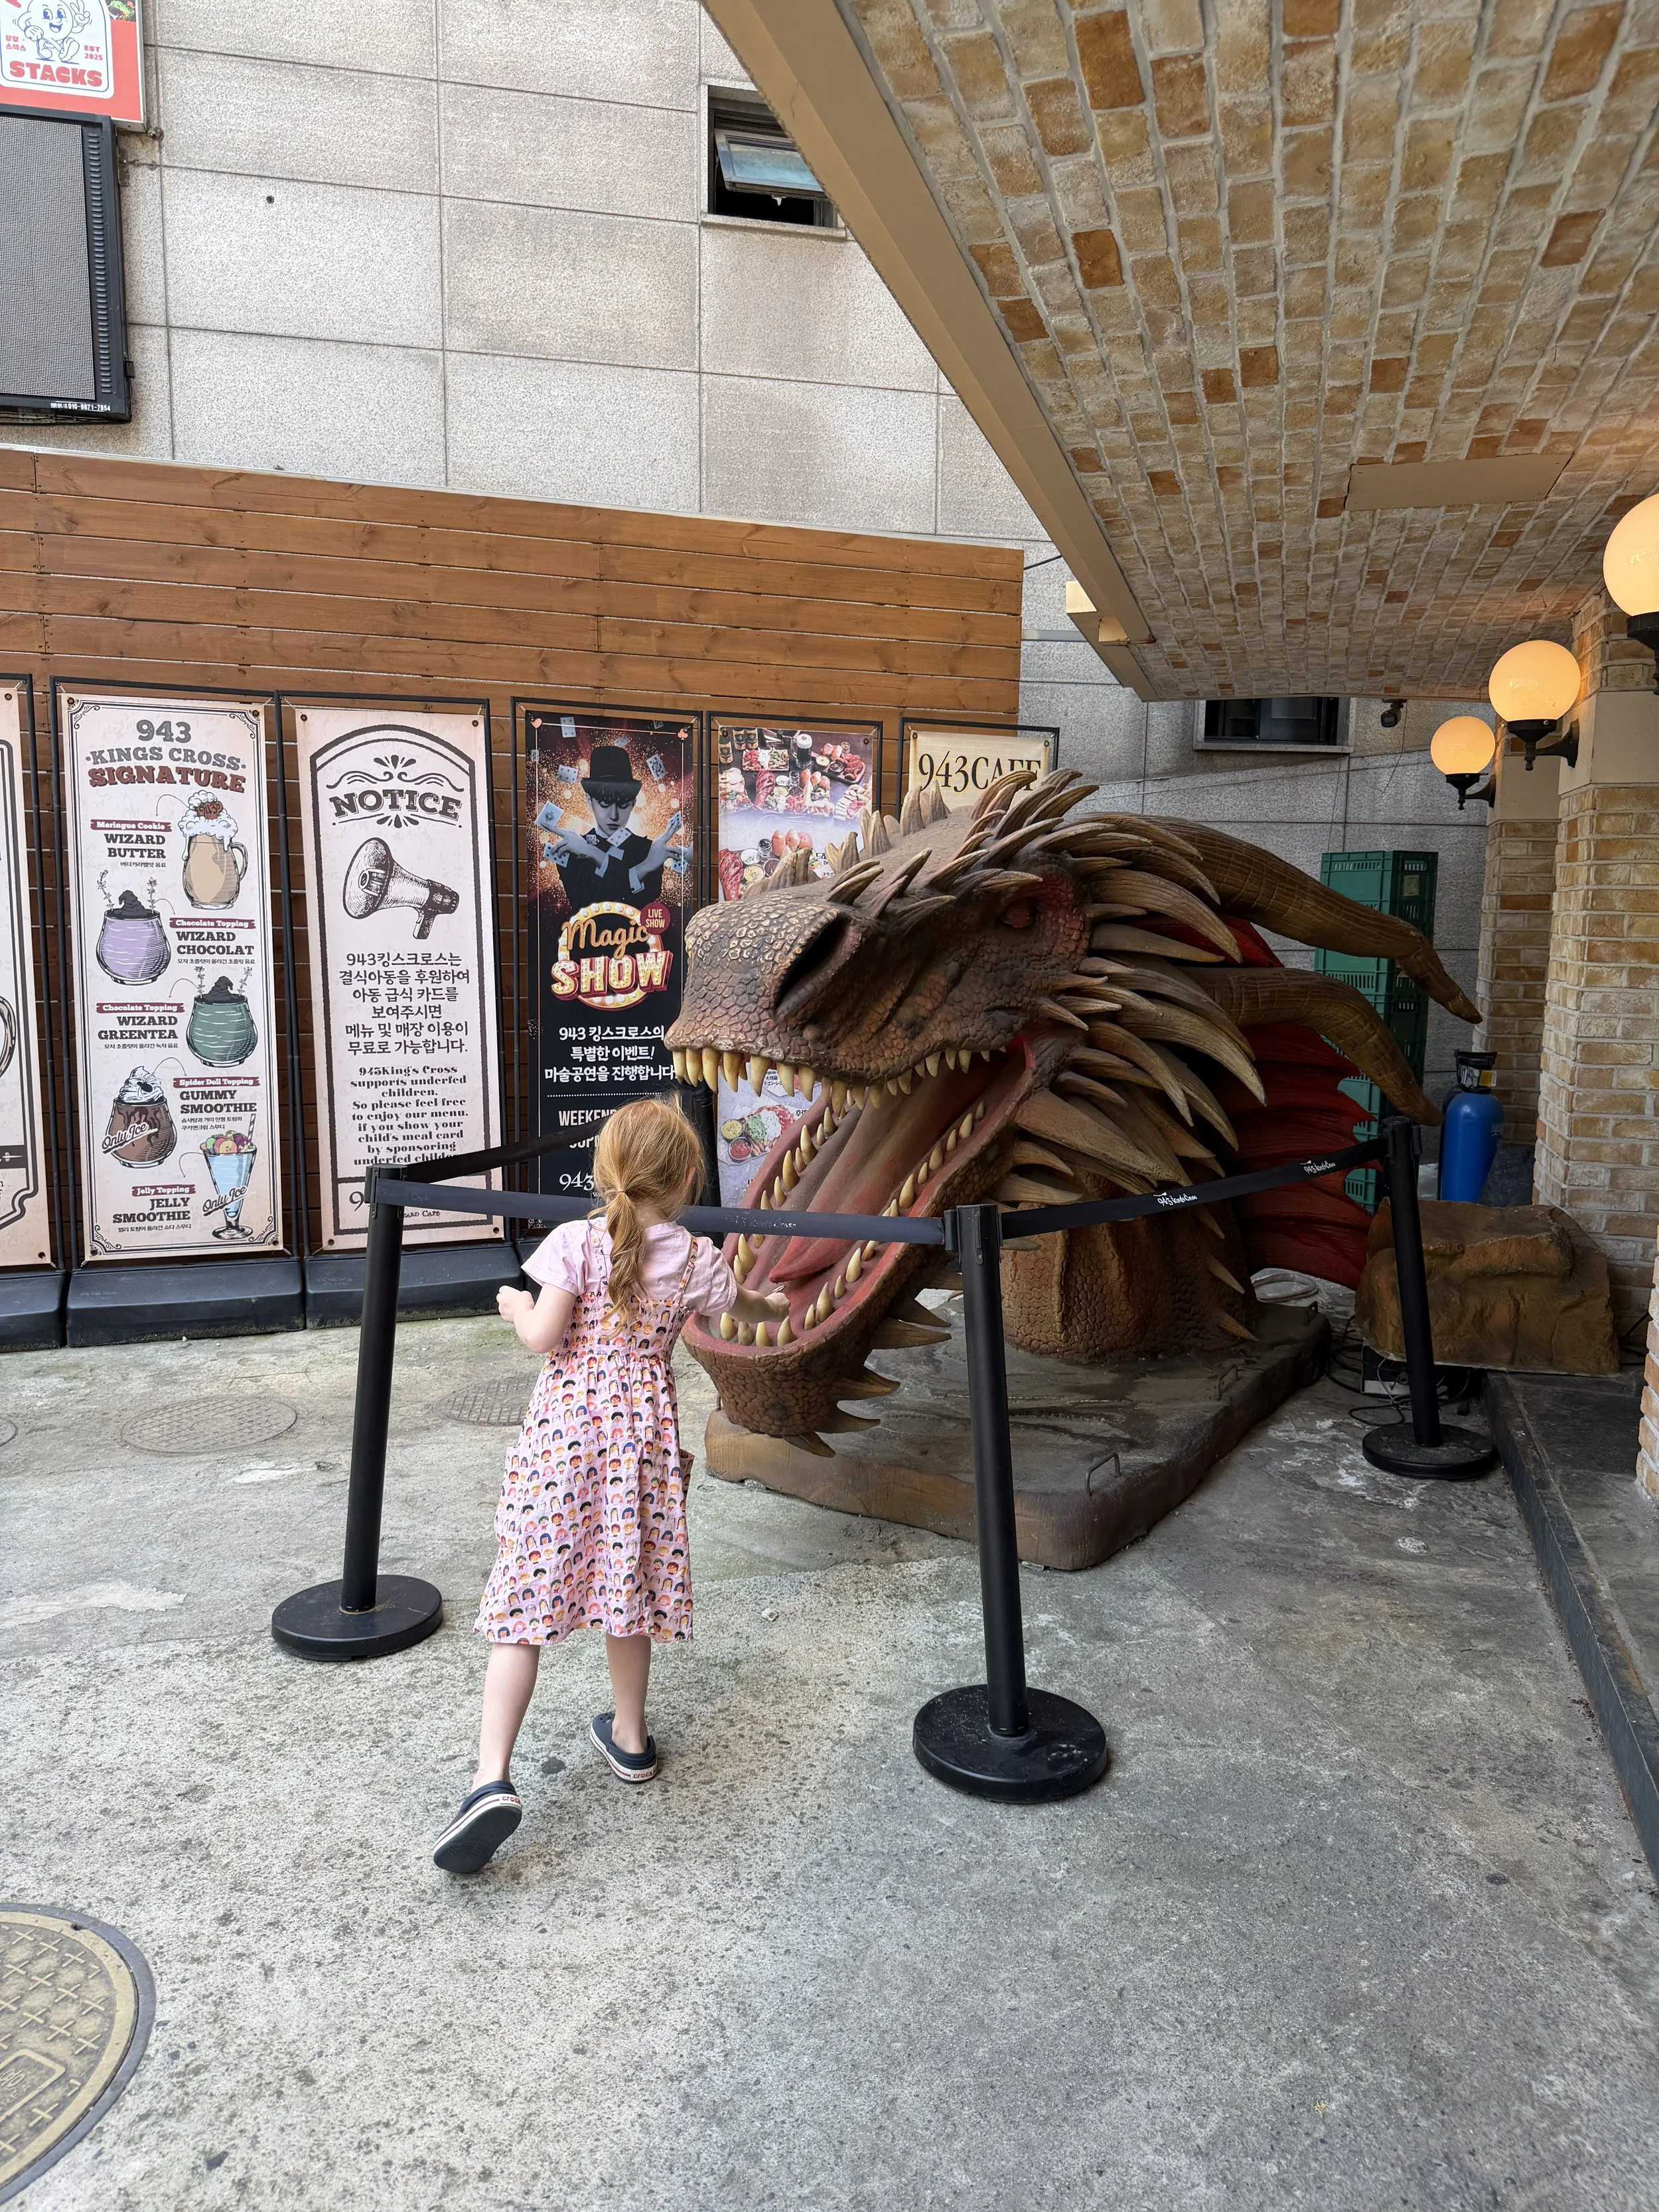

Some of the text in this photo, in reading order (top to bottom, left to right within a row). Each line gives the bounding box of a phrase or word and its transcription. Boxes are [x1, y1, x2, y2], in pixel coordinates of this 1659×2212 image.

[84, 52, 104, 61] 2025
[9, 60, 103, 87] STACKS
[136, 719, 192, 744] 943
[87, 765, 247, 794] SIGNATURE
[328, 788, 463, 822] NOTICE
[96, 821, 166, 831] Meringue Cookie
[104, 833, 166, 846] WIZARD
[108, 848, 167, 859] BUTTER
[648, 908, 663, 919] LIVE
[175, 919, 250, 929] Chocolate Topping
[645, 918, 666, 929] SHOW
[176, 930, 236, 942] WIZARD
[561, 918, 649, 960] Magic
[177, 944, 255, 956] CHOCOLAT
[346, 952, 463, 968] 943킹스크로스는
[338, 968, 470, 987] 결식아동을 후원하여
[551, 950, 674, 1000] SHOW
[352, 986, 459, 1003] 아동 급식 카드를
[102, 1003, 178, 1013] Chocolate Topping
[371, 1003, 443, 1021] 보여주시면
[117, 1015, 178, 1027] WIZARD
[98, 1029, 179, 1041] GREENTEA
[345, 1020, 469, 1040] 메뉴 및 매장 이용이
[558, 1024, 665, 1042] 943 킹스크로스의
[347, 1038, 469, 1057] 무료로 가능합니다.
[570, 1045, 655, 1062] 특별한 이벤트!
[422, 1065, 459, 1075] Cross
[544, 1065, 678, 1083] 마술공연을 진행합니다.
[179, 1078, 254, 1087] Spider Doll Topping
[350, 1074, 467, 1090] supports underfed
[179, 1089, 238, 1101] GUMMY
[381, 1087, 439, 1098] children.
[180, 1102, 257, 1114] SMOOTHIE
[352, 1098, 467, 1112] So please feel free
[352, 1110, 469, 1123] to enjoy our menu.
[558, 1109, 617, 1126] WEEKEN
[358, 1120, 464, 1134] if you show your
[102, 1122, 149, 1149] Only Ice
[358, 1129, 464, 1143] child's meal card
[367, 1141, 457, 1155] by sponsoring
[353, 1153, 411, 1165] underfed
[135, 1185, 190, 1195] Jelly Topping
[149, 1197, 190, 1211] JELLY
[202, 1185, 247, 1213] Only Ice
[112, 1211, 191, 1224] SMOOTHIE
